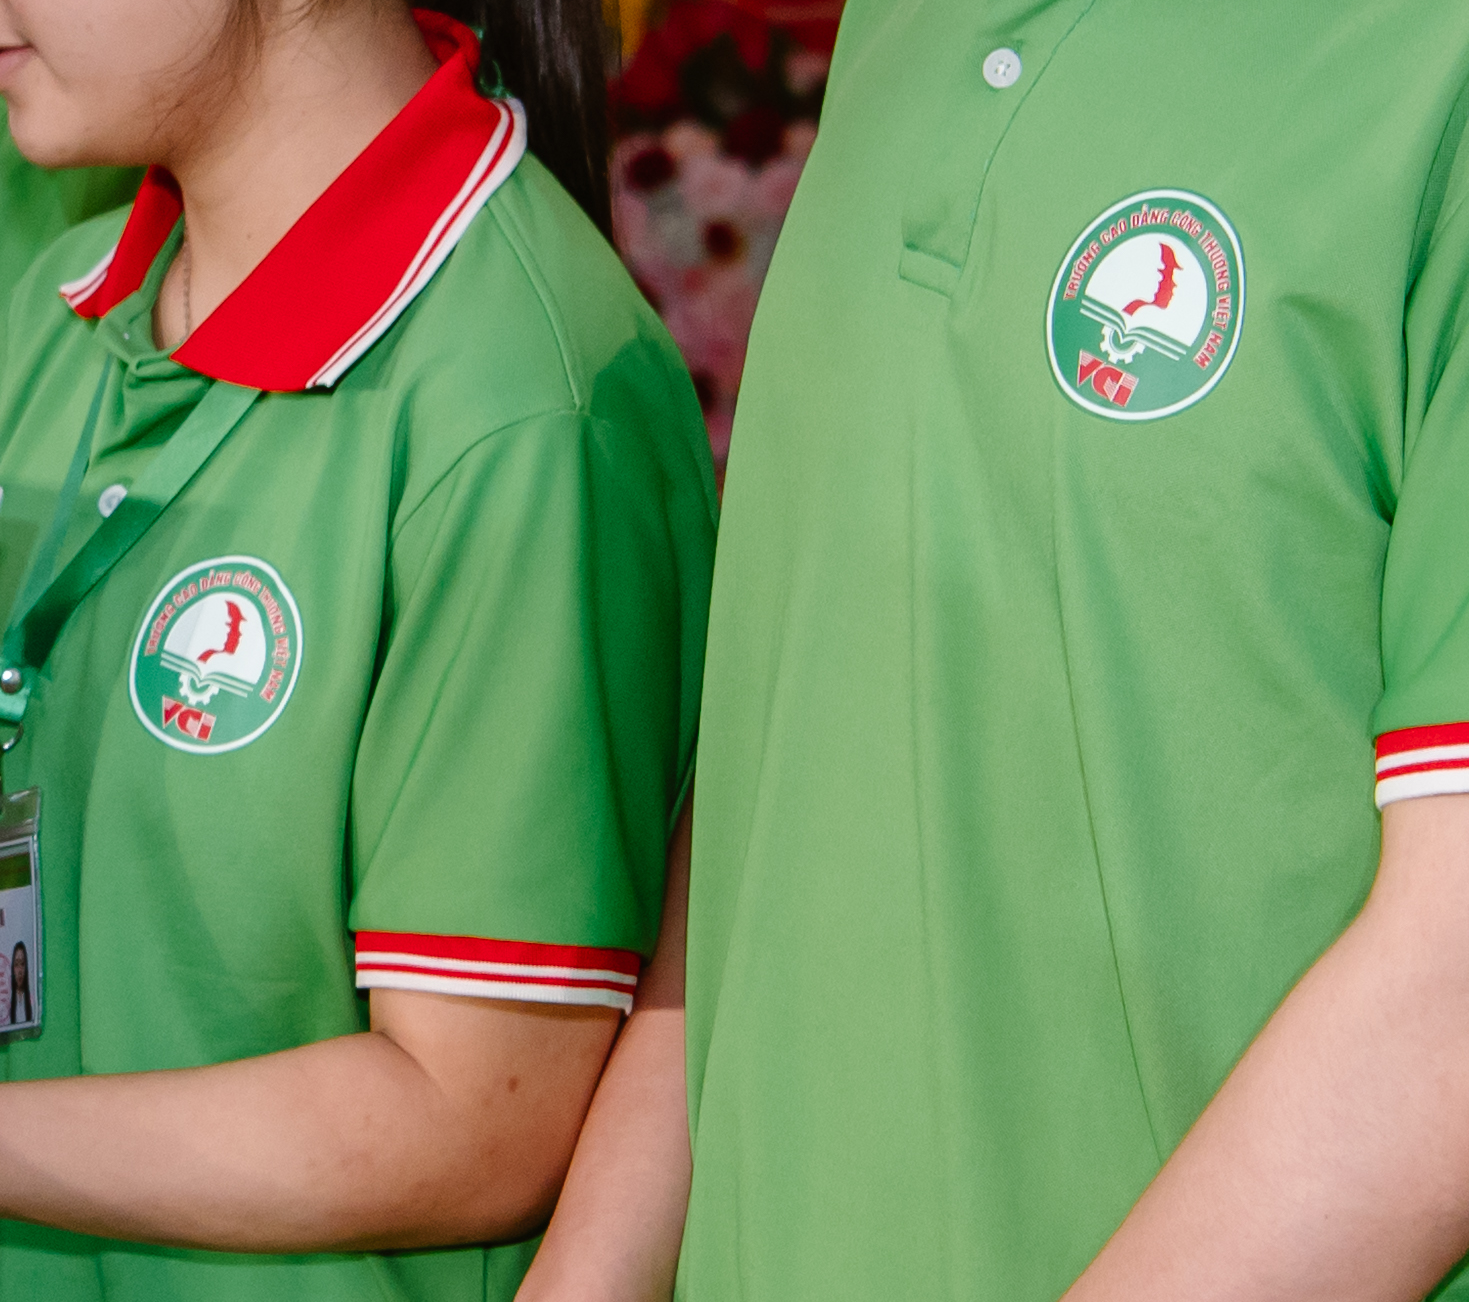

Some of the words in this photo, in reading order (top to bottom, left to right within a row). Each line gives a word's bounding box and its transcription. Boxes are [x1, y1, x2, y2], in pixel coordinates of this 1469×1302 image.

[1100, 219, 1125, 243] CAO
[1170, 211, 1200, 236] CÔNG
[1193, 331, 1222, 368] NAM
[173, 584, 196, 605] CAO
